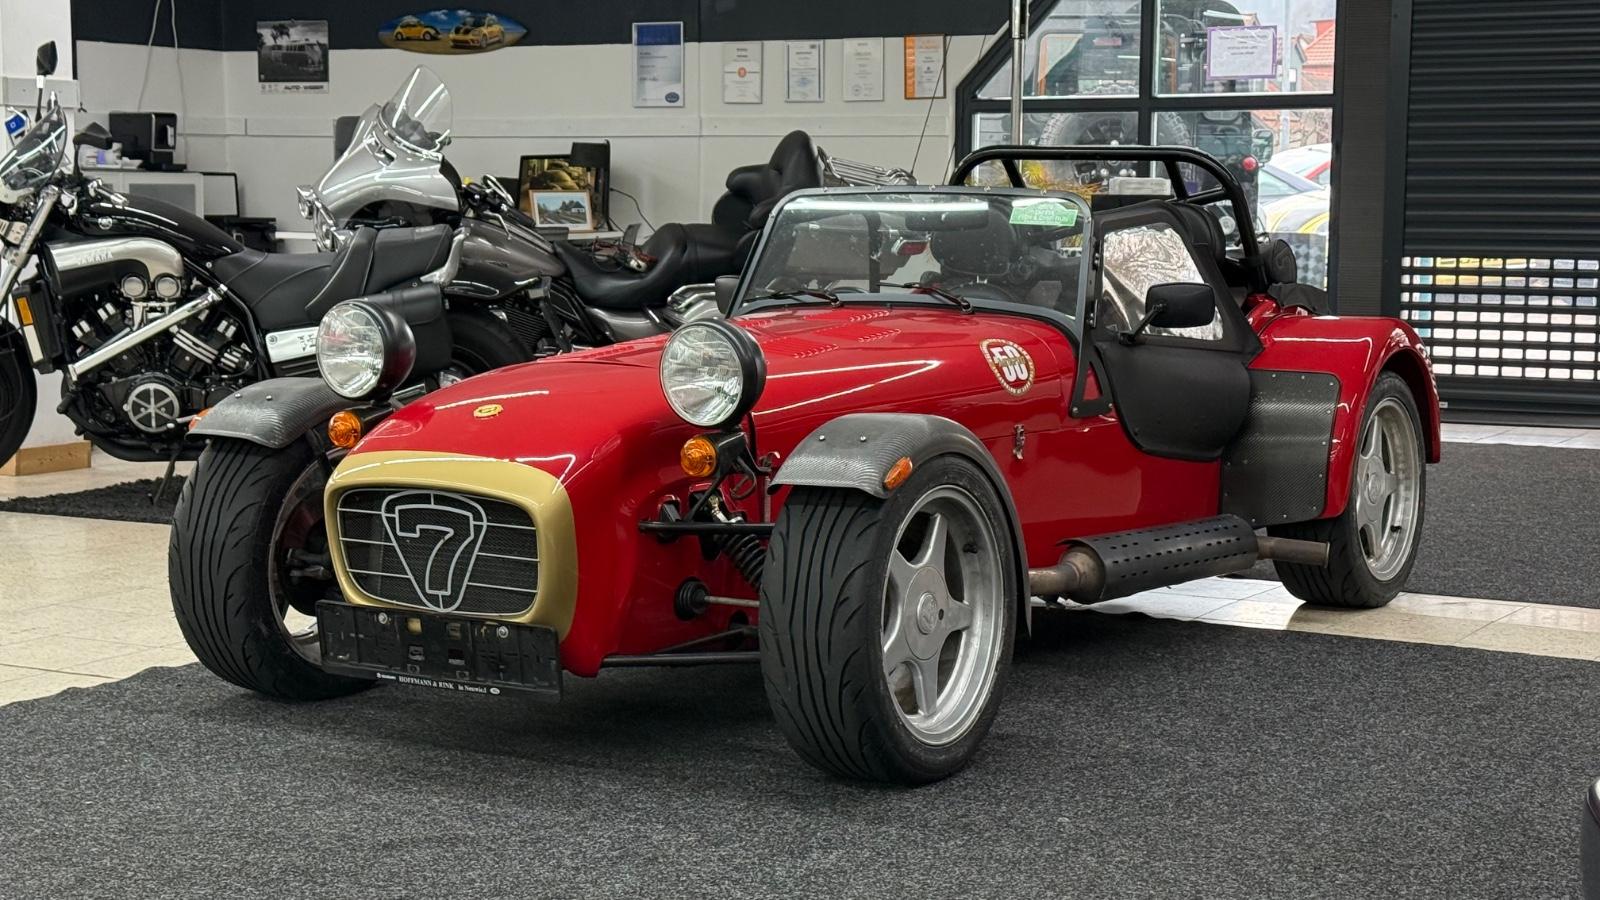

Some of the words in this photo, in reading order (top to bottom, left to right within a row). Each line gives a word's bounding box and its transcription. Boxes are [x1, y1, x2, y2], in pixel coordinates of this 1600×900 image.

[395, 504, 474, 596] 7
[399, 676, 432, 687] HOFFMANN
[432, 680, 438, 688] &
